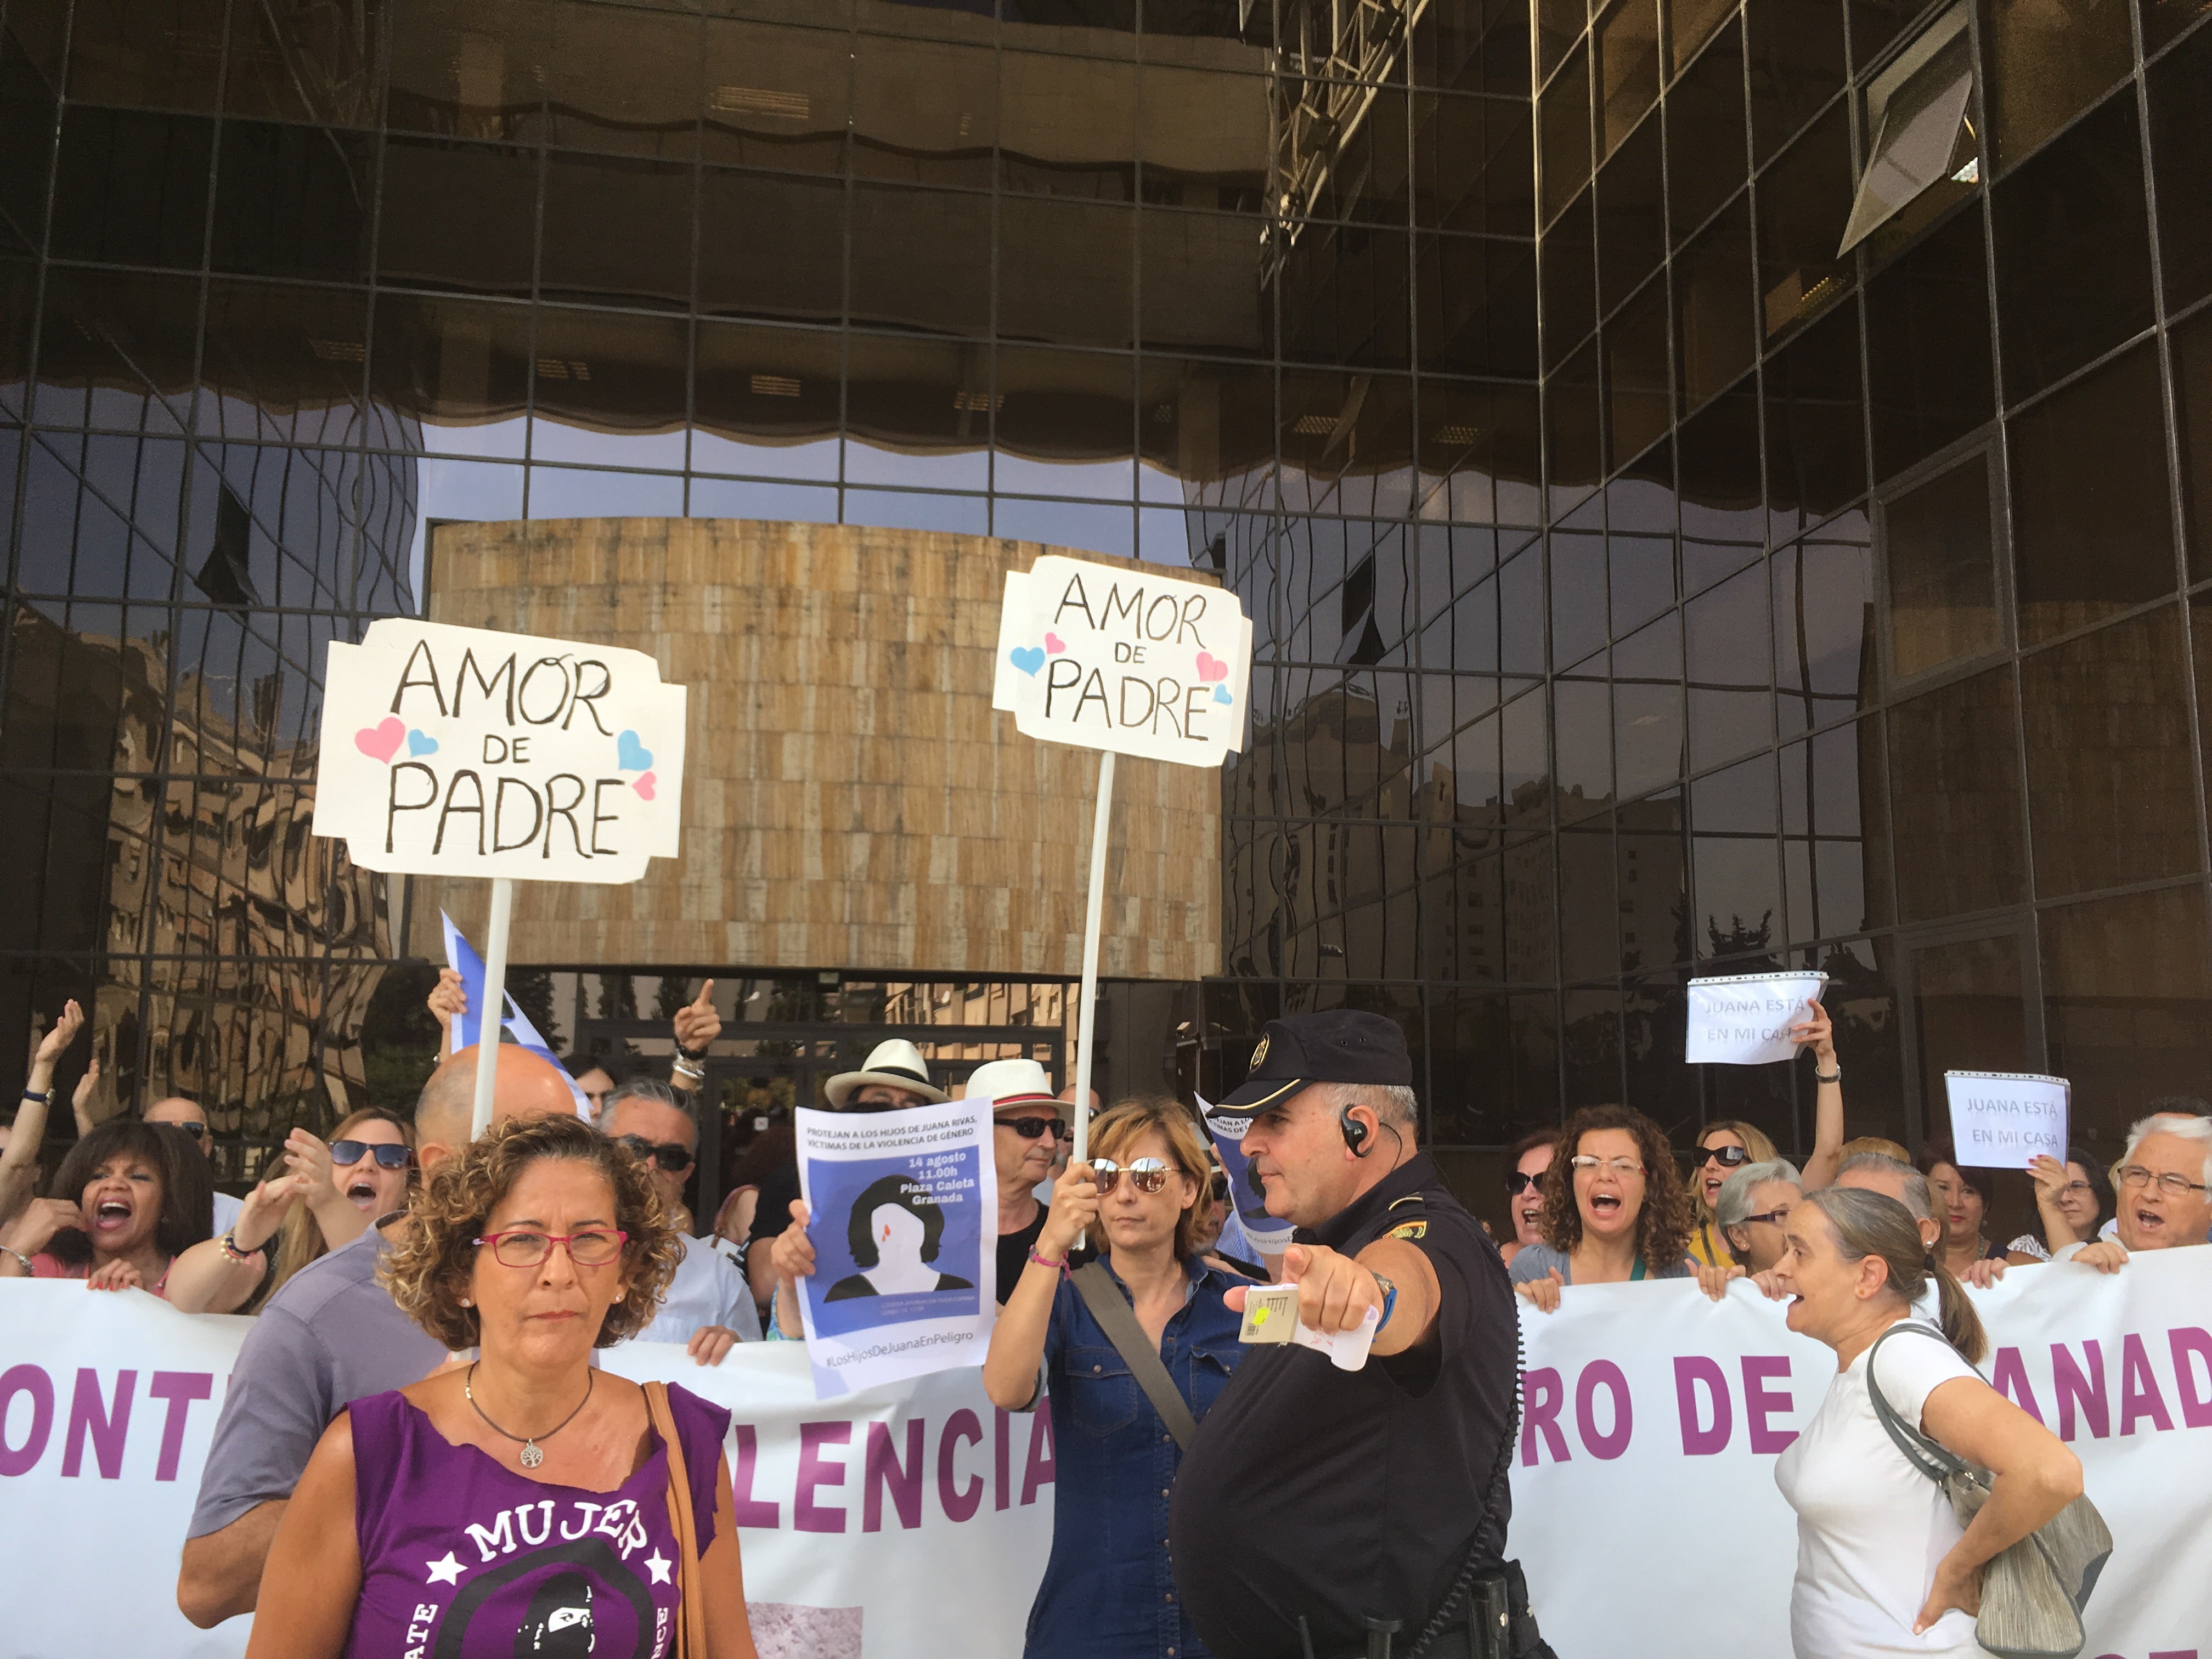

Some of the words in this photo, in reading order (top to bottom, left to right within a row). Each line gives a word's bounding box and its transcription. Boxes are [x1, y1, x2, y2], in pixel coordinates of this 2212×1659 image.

[1054, 572, 1206, 649] AMOR
[1114, 642, 1147, 664] DE
[390, 639, 613, 736] AMOR
[1045, 658, 1210, 741] PADRE
[483, 734, 531, 764] DE
[385, 761, 625, 859] PADRE
[1705, 1000, 1760, 1013] JUANA
[1766, 996, 1805, 1011] ESTÁ
[1707, 1028, 1728, 1040] EN
[1734, 1028, 1756, 1040] MI
[1967, 1098, 2020, 1113] JUANA
[2024, 1101, 2057, 1117] ESTÁ
[807, 1127, 850, 1138] PROTEJAN
[861, 1130, 878, 1138] LOS
[880, 1127, 906, 1136] HIJOS
[908, 1125, 920, 1133] DE
[922, 1120, 950, 1132] JUANA
[951, 1115, 978, 1127] RIVAS,
[1972, 1129, 1993, 1143] EN
[1998, 1130, 2018, 1144] MI
[2024, 1132, 2058, 1147] CASA
[849, 1142, 861, 1150] DE
[864, 1141, 875, 1149] LA
[877, 1135, 924, 1148] VIOLENCIA
[927, 1134, 939, 1142] DE
[940, 1127, 974, 1140] GÉNERO
[909, 1156, 923, 1168] 14
[926, 1152, 966, 1168] agosto
[918, 1166, 958, 1180] 11.00h
[900, 1182, 934, 1194] Plaza
[936, 1177, 975, 1191] Caleta
[912, 1192, 963, 1205] Granada
[827, 1331, 974, 1367] #LosHijosDeJuanaEnPeligro
[0, 1364, 233, 1481] ONT
[733, 1395, 1056, 1533] LENCIA
[1520, 1359, 1633, 1467] RO
[1673, 1356, 1801, 1455] DE
[1993, 1327, 2212, 1442] ANAD
[464, 1499, 649, 1562] MUJER
[404, 1604, 438, 1659] ATE
[651, 1607, 669, 1659] NCE
